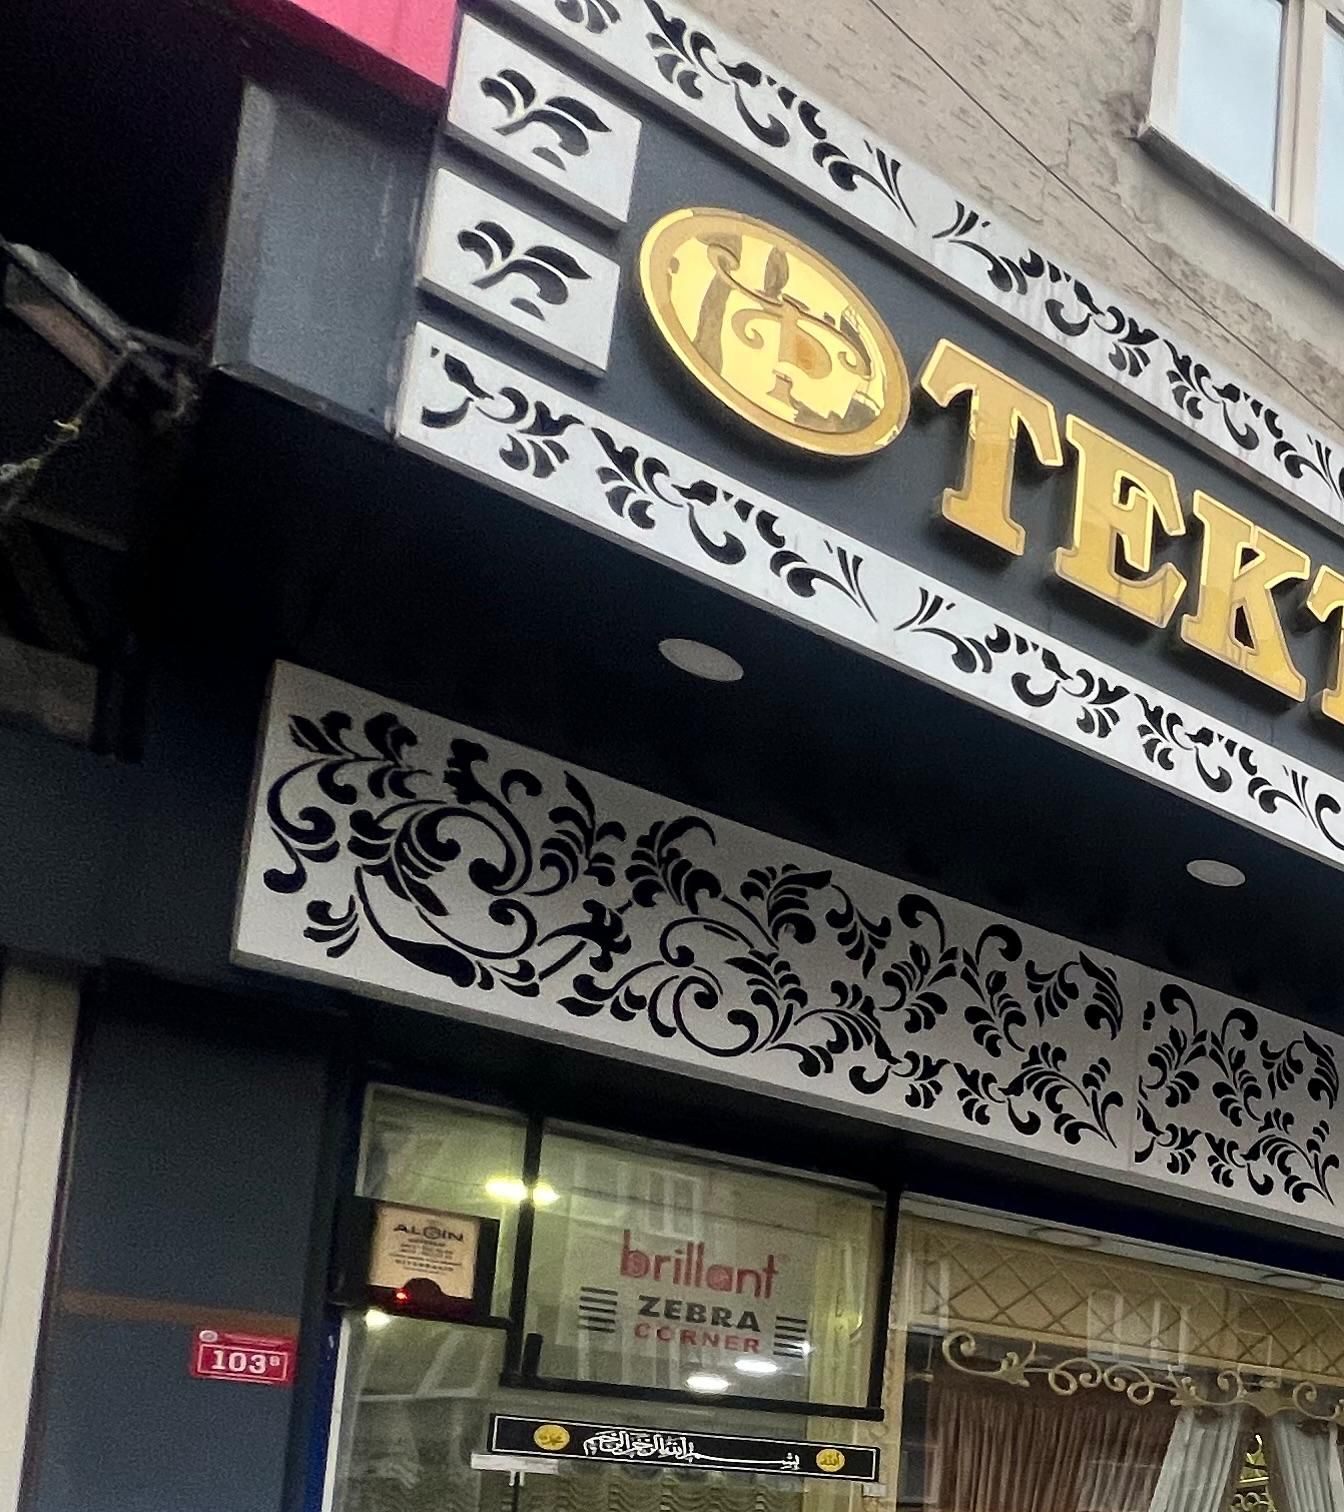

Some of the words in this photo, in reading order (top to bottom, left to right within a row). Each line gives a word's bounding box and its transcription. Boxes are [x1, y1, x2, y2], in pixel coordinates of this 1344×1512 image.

[620, 1229, 780, 1298] brillant
[638, 1294, 761, 1333] ZEBRA
[633, 1322, 761, 1354] CORNER
